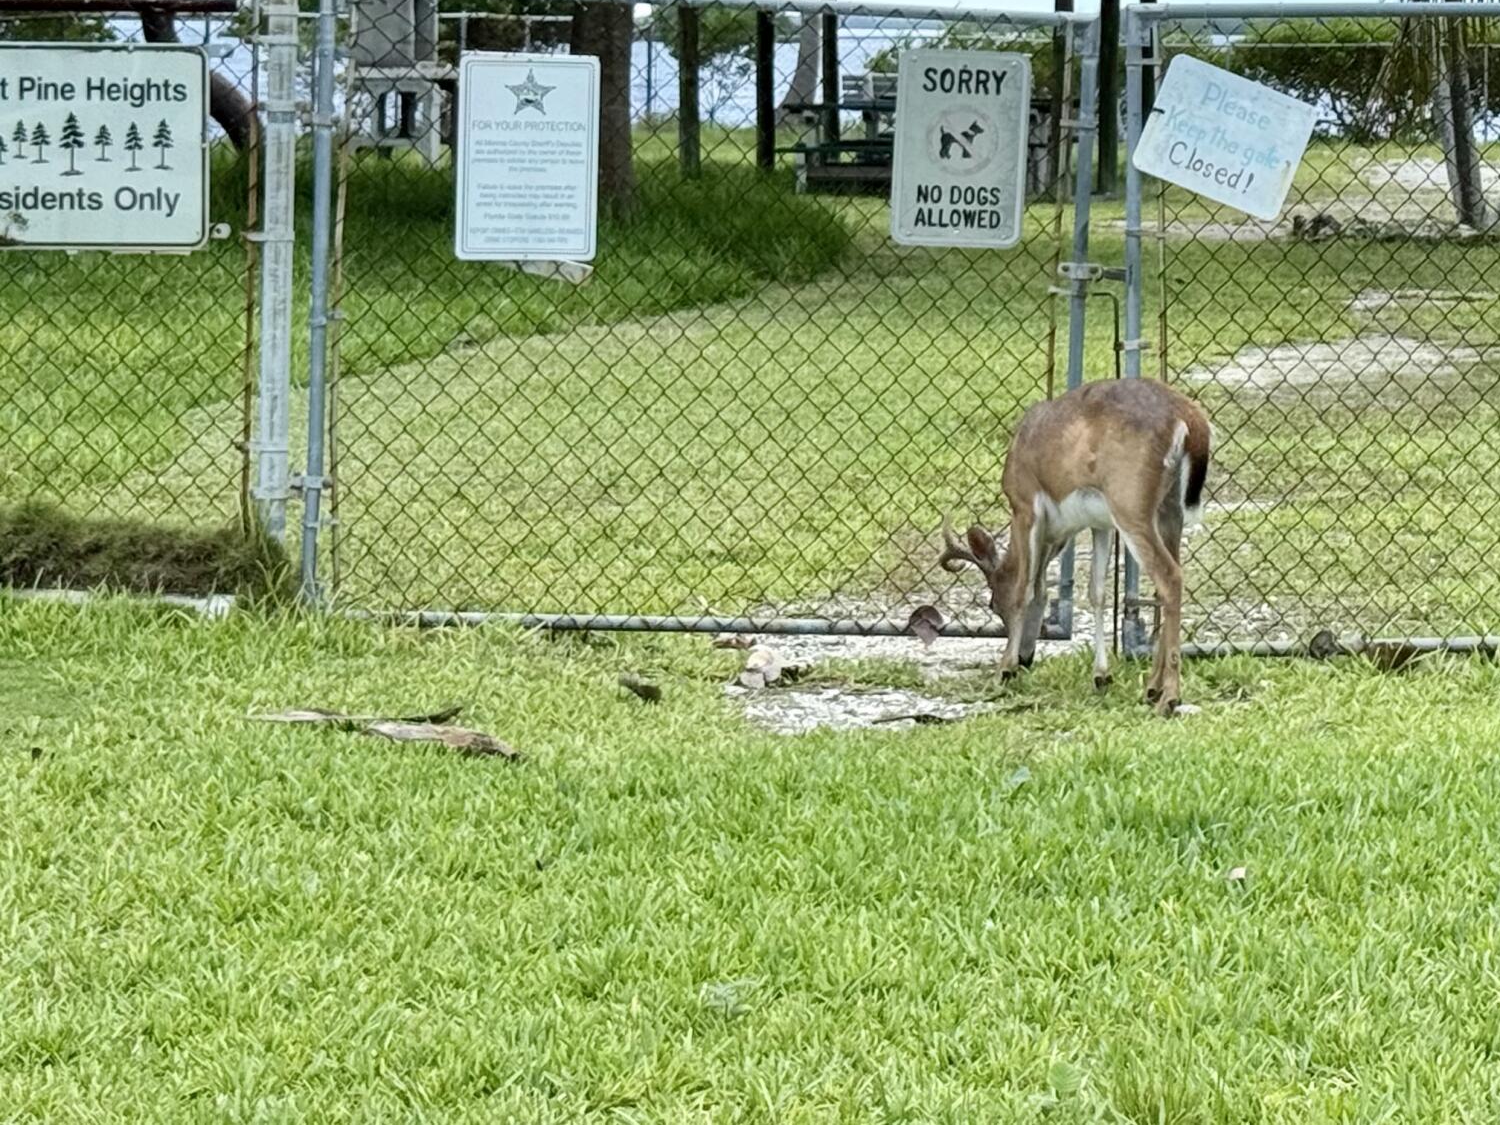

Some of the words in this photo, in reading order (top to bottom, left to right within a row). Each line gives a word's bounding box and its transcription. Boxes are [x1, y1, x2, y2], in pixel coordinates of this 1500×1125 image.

[19, 76, 76, 101] Pine
[86, 76, 188, 108] Heights
[922, 67, 1008, 96] SORRY
[1200, 81, 1271, 131] Please
[472, 119, 492, 131] FOR
[494, 119, 522, 132] YOUR
[524, 120, 586, 132] PROTECTION
[1168, 141, 1255, 194] Closed!
[0, 186, 103, 210] sidents
[114, 186, 180, 218] Only
[916, 184, 942, 204] NO
[950, 185, 1001, 206] DOGS
[914, 207, 1001, 229] ALLOWED
